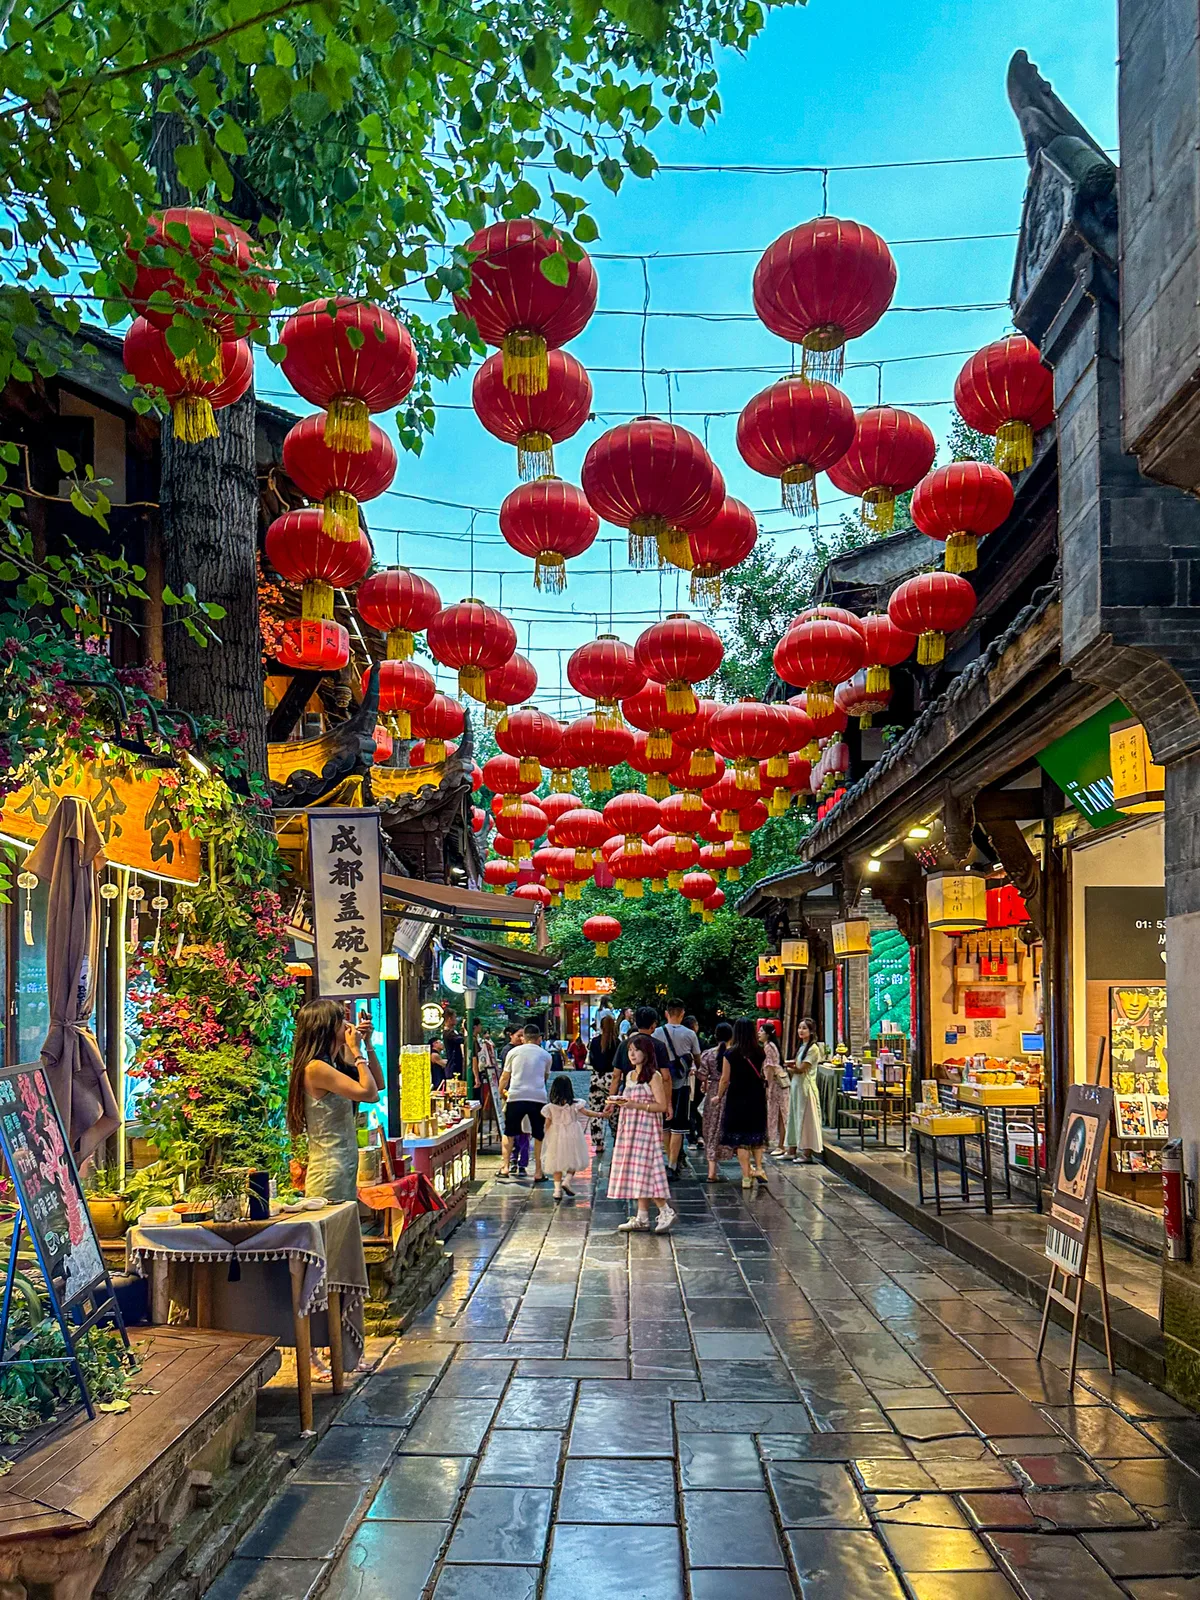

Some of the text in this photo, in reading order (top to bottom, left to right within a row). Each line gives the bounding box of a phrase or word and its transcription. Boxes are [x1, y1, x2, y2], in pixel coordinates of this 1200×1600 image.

[328, 824, 371, 988] 成都盖碗茶
